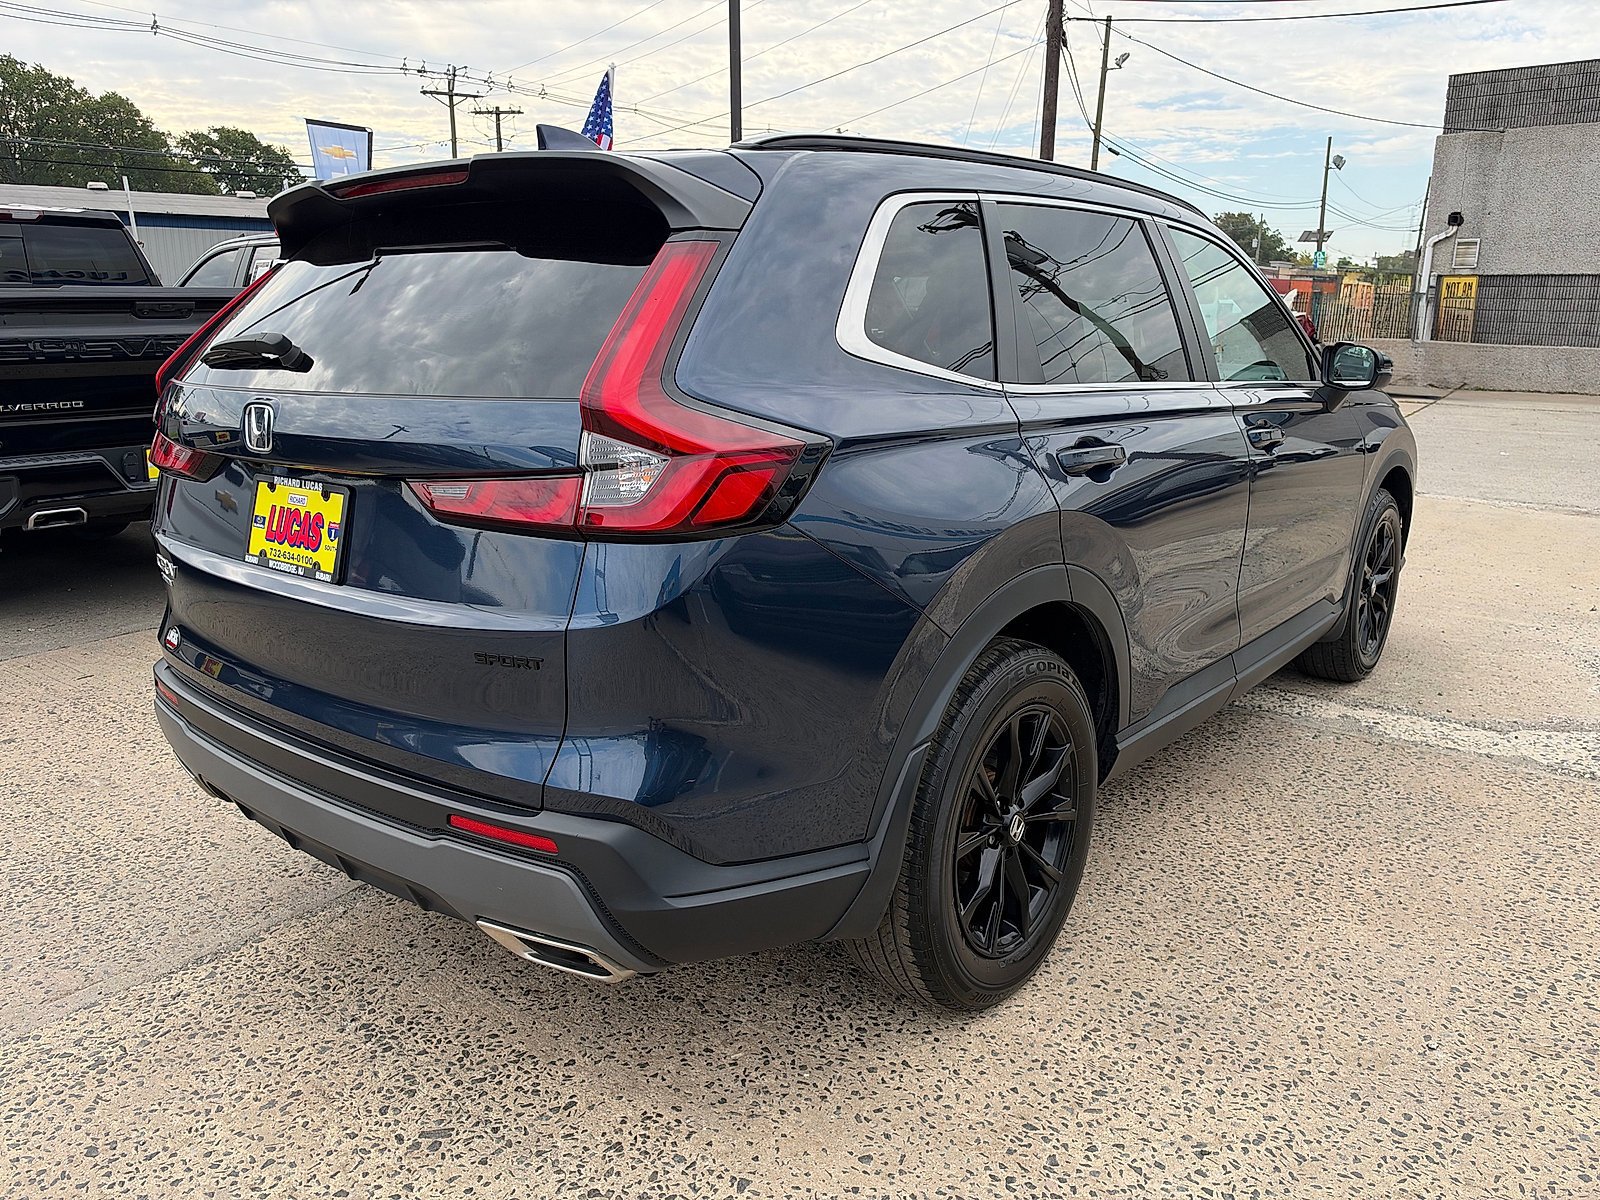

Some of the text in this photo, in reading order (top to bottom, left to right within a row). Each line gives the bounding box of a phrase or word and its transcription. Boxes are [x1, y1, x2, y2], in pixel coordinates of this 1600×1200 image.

[1445, 282, 1461, 298] NOT
[273, 476, 323, 491] RICHARD LUCAS
[265, 504, 324, 553] LUCAS
[330, 529, 336, 540] 1
[269, 547, 313, 565] 732-634-0100
[473, 651, 544, 670] SPORT
